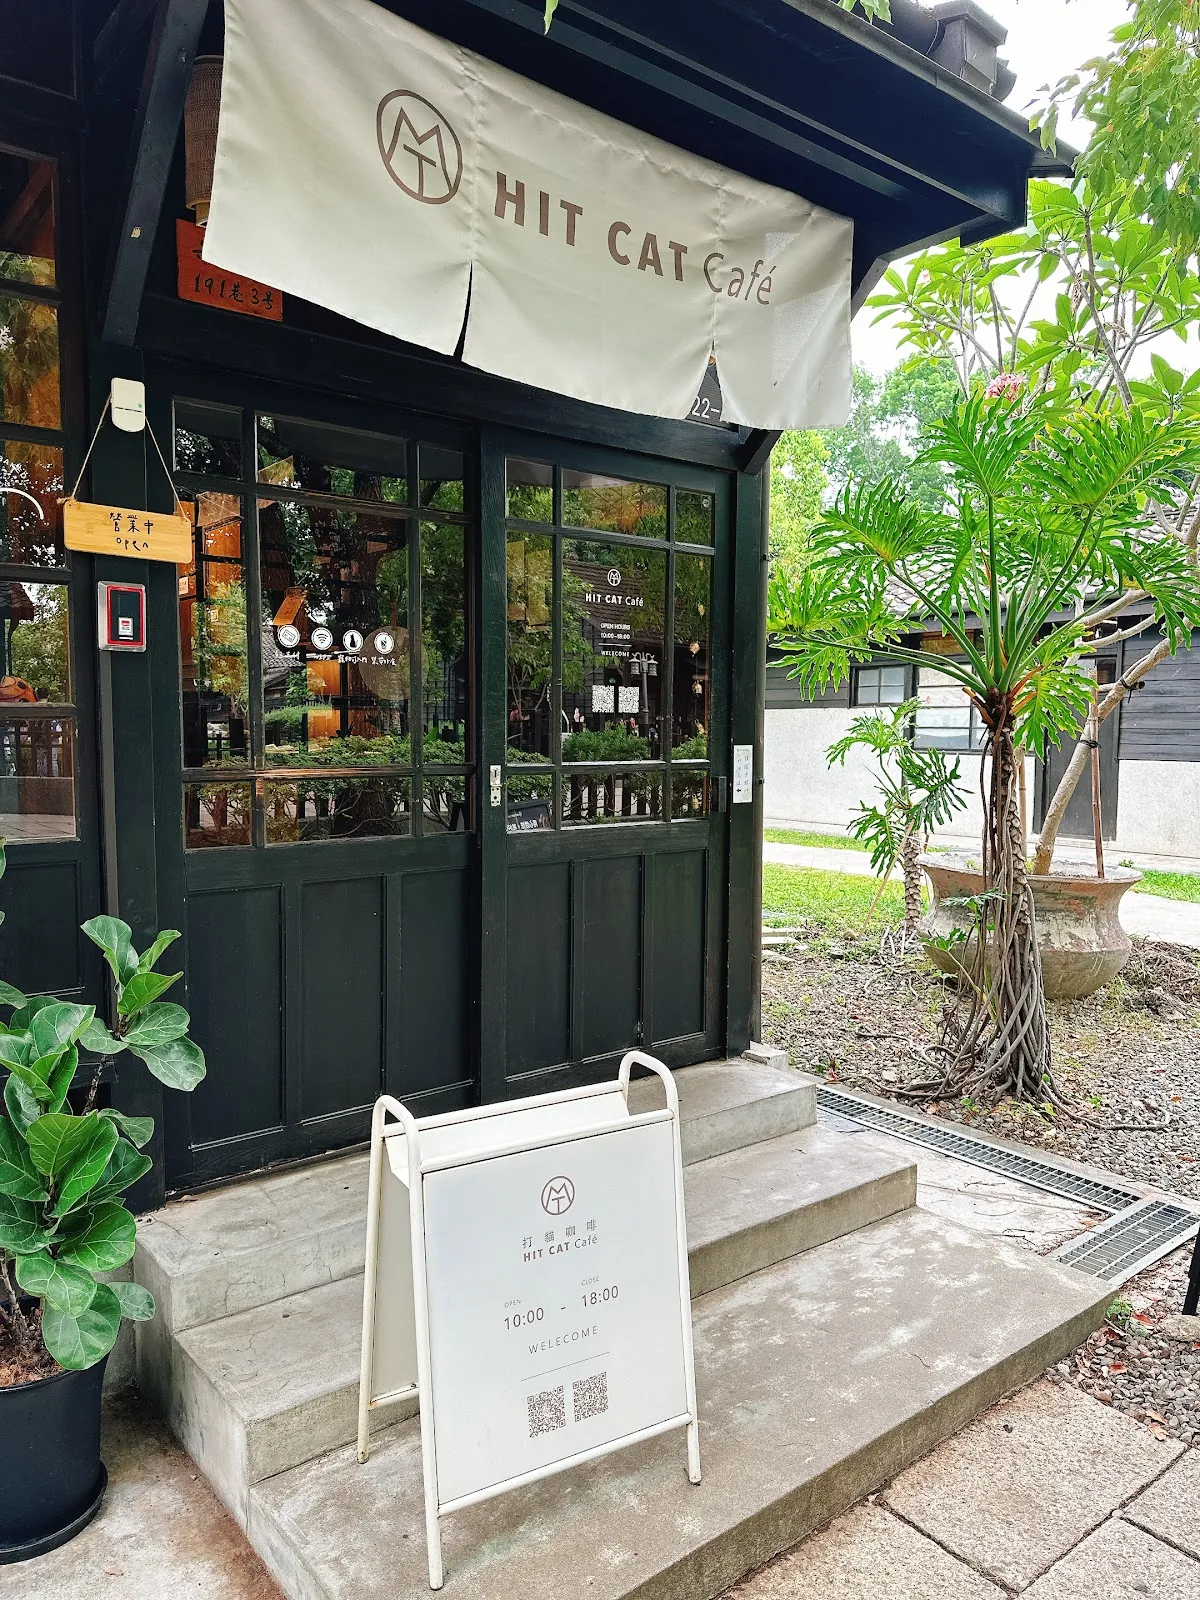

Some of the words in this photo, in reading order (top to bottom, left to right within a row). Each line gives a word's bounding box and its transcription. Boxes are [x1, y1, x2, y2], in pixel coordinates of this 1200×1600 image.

[494, 171, 583, 246] HIT
[608, 221, 688, 281] CAT
[704, 253, 777, 305] Café
[585, 593, 601, 603] HIT
[605, 595, 622, 605] CAT
[625, 597, 644, 607] Café
[522, 1219, 597, 1249] 打貓咖啡
[523, 1248, 544, 1262] HIT
[548, 1241, 570, 1255] CAT
[574, 1234, 598, 1249] Café
[581, 1275, 600, 1286] CLOSE
[504, 1299, 521, 1308] OPEN
[504, 1307, 544, 1330] 10:00
[581, 1285, 619, 1307] 18:00
[528, 1325, 598, 1354] WELECOME
